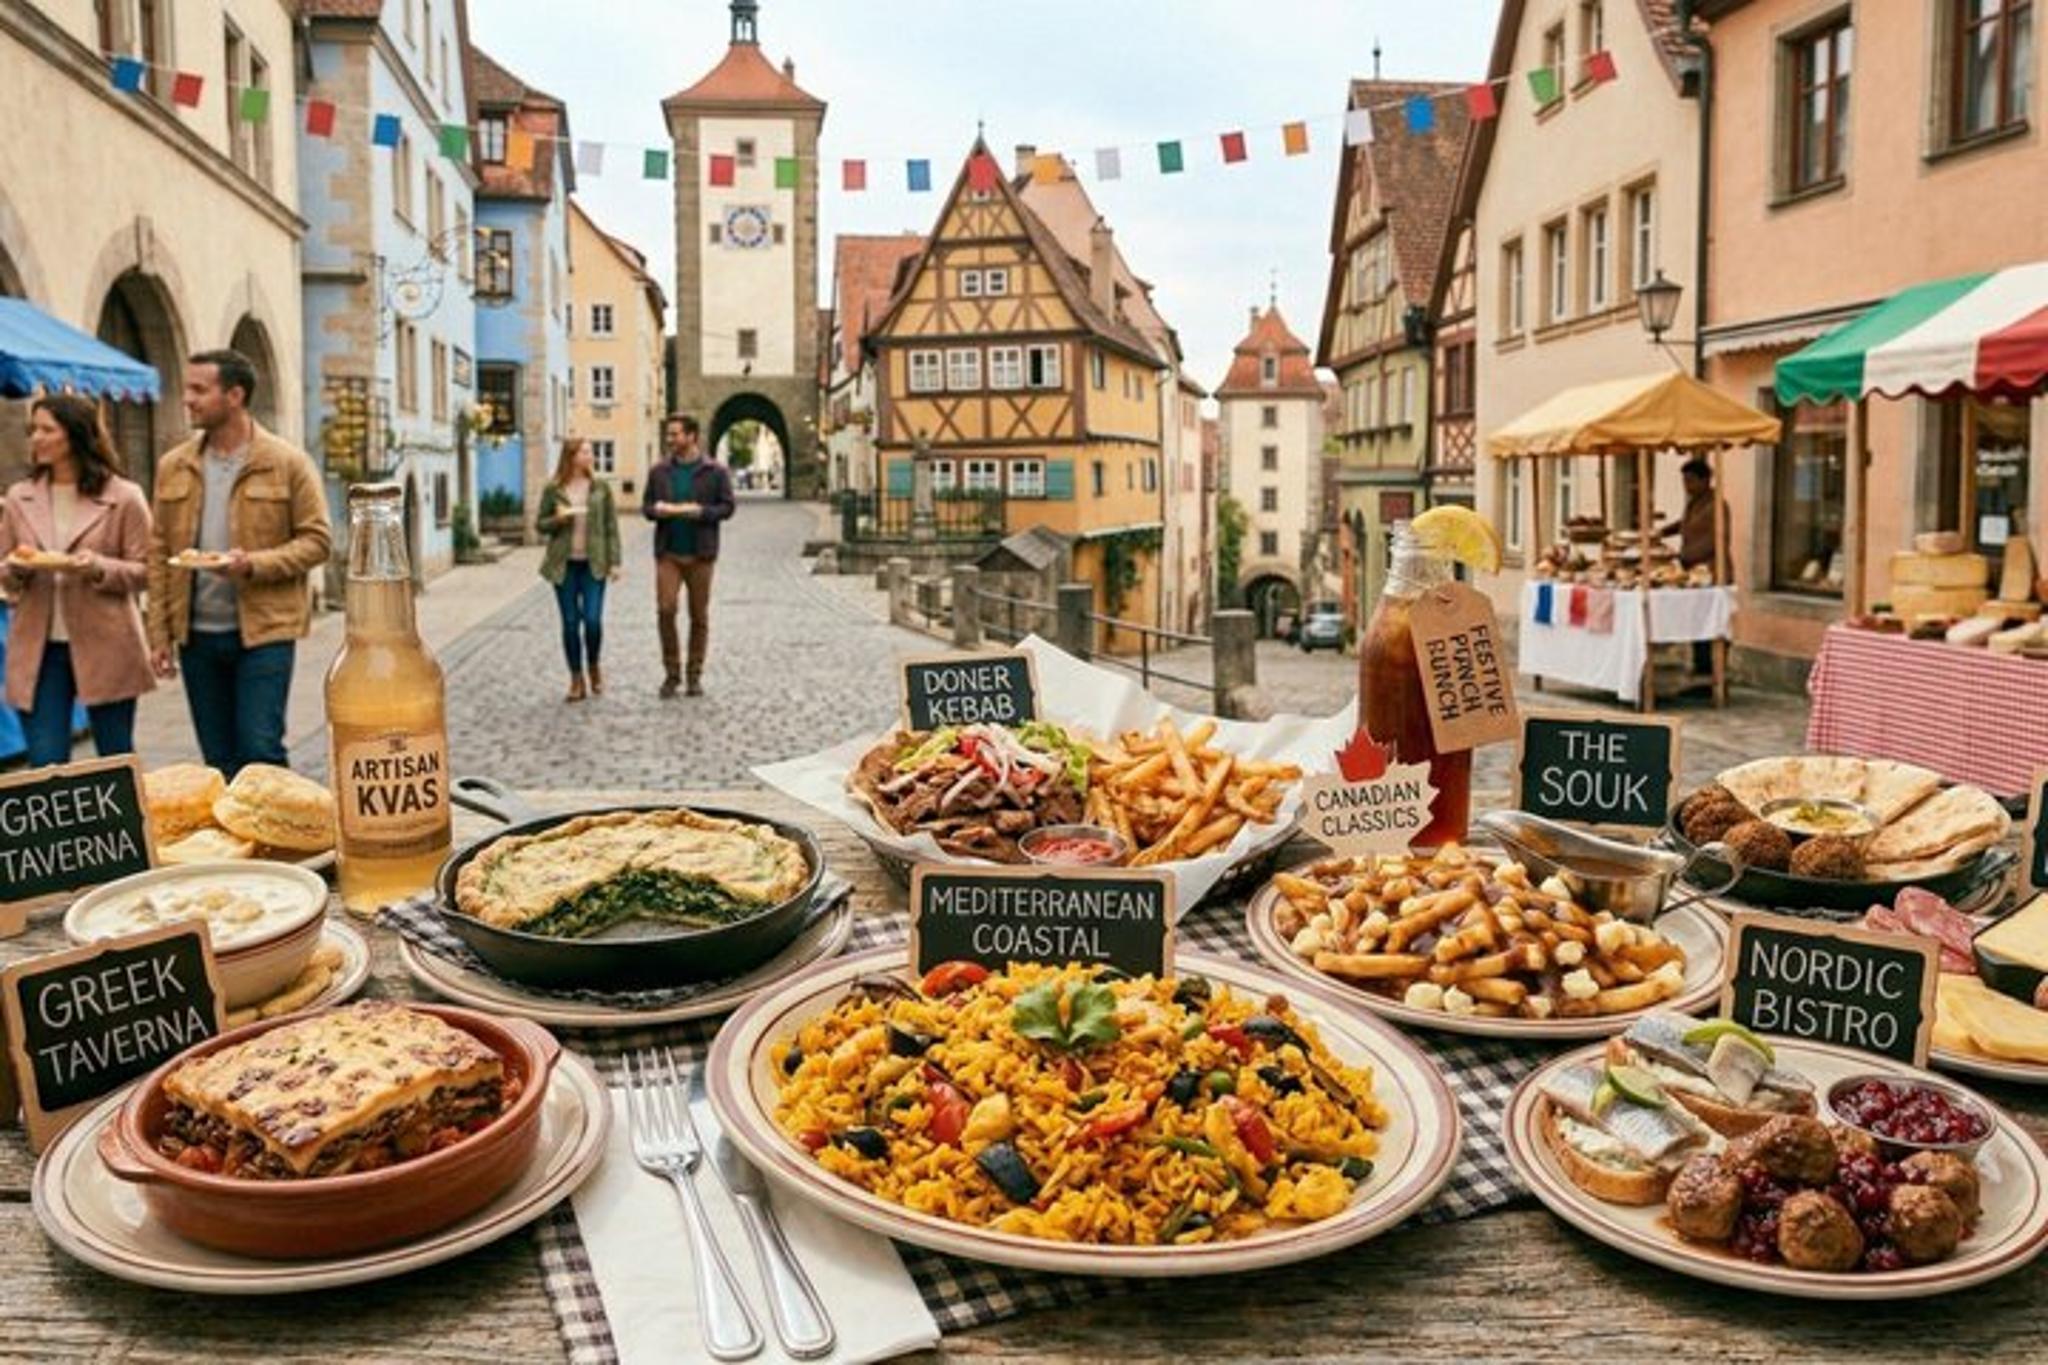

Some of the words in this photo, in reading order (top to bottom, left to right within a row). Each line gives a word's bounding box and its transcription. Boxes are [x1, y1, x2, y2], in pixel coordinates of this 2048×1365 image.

[923, 665, 1012, 694] DONER
[1470, 625, 1508, 718] FESTIVE
[927, 693, 1016, 724] KEBAB
[352, 750, 439, 780] ARTISAN
[1559, 730, 1628, 763] THE
[357, 778, 439, 816] KVAS
[1314, 780, 1420, 812] CANADIAN
[1539, 766, 1648, 812] SOUK
[1, 782, 122, 837] GREEK
[1322, 806, 1420, 837] CLASSICS
[0, 829, 138, 883] TAVERNA
[930, 886, 1154, 920] MEDITERRANEAN
[972, 923, 1111, 958] COASTAL
[1751, 939, 1904, 999] NORDIC
[39, 954, 186, 1028] GREEK
[1751, 989, 1899, 1049] BISTRO
[39, 1006, 209, 1085] TAVERNA
